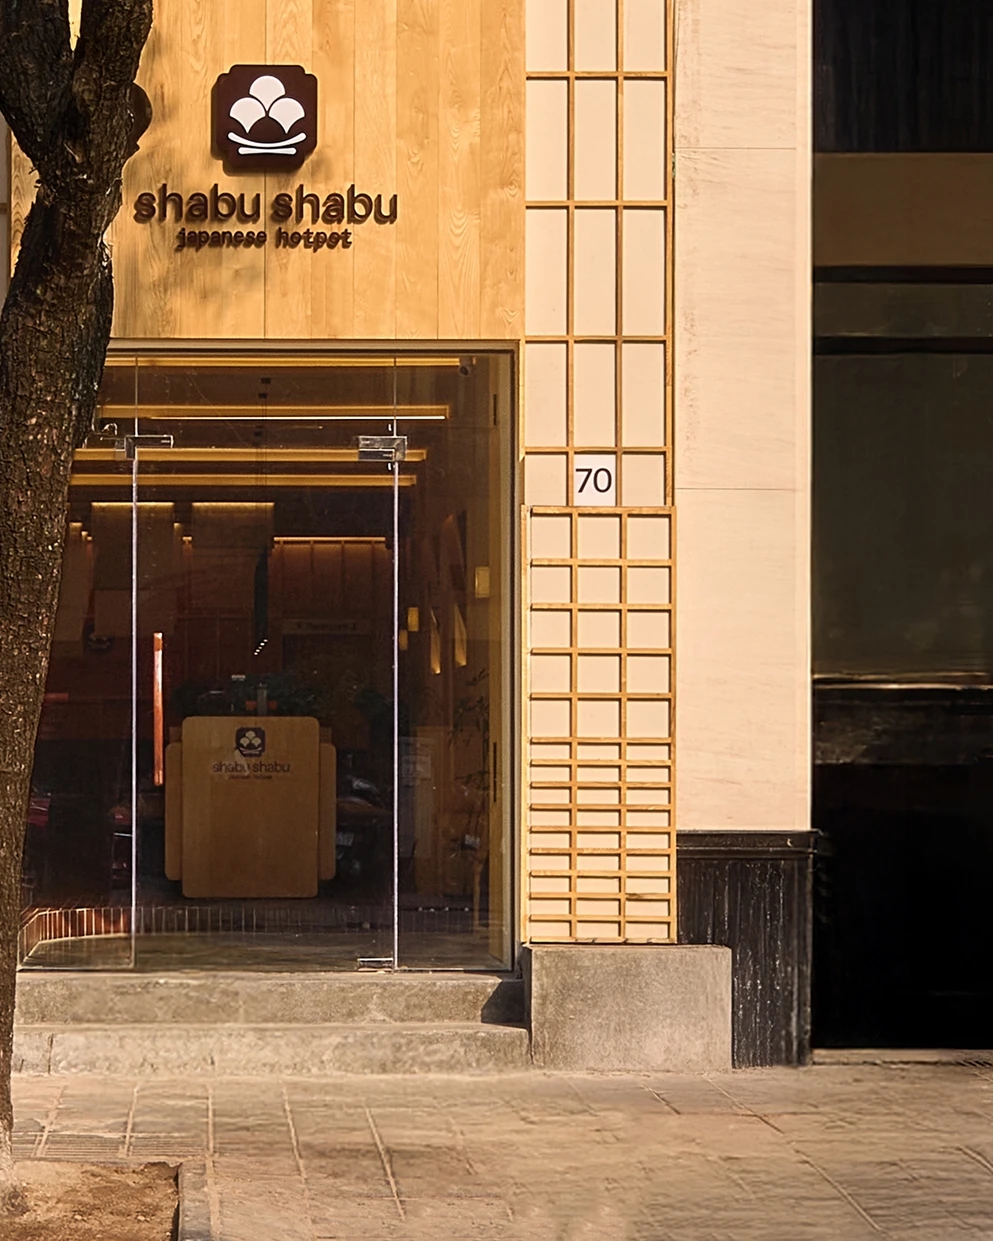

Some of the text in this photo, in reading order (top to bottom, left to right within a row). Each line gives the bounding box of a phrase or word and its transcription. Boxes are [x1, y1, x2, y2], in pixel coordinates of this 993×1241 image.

[134, 183, 398, 224] shabu shabu
[175, 227, 353, 253] japanese hotpot
[575, 467, 612, 493] 70
[252, 761, 291, 773] shabu
